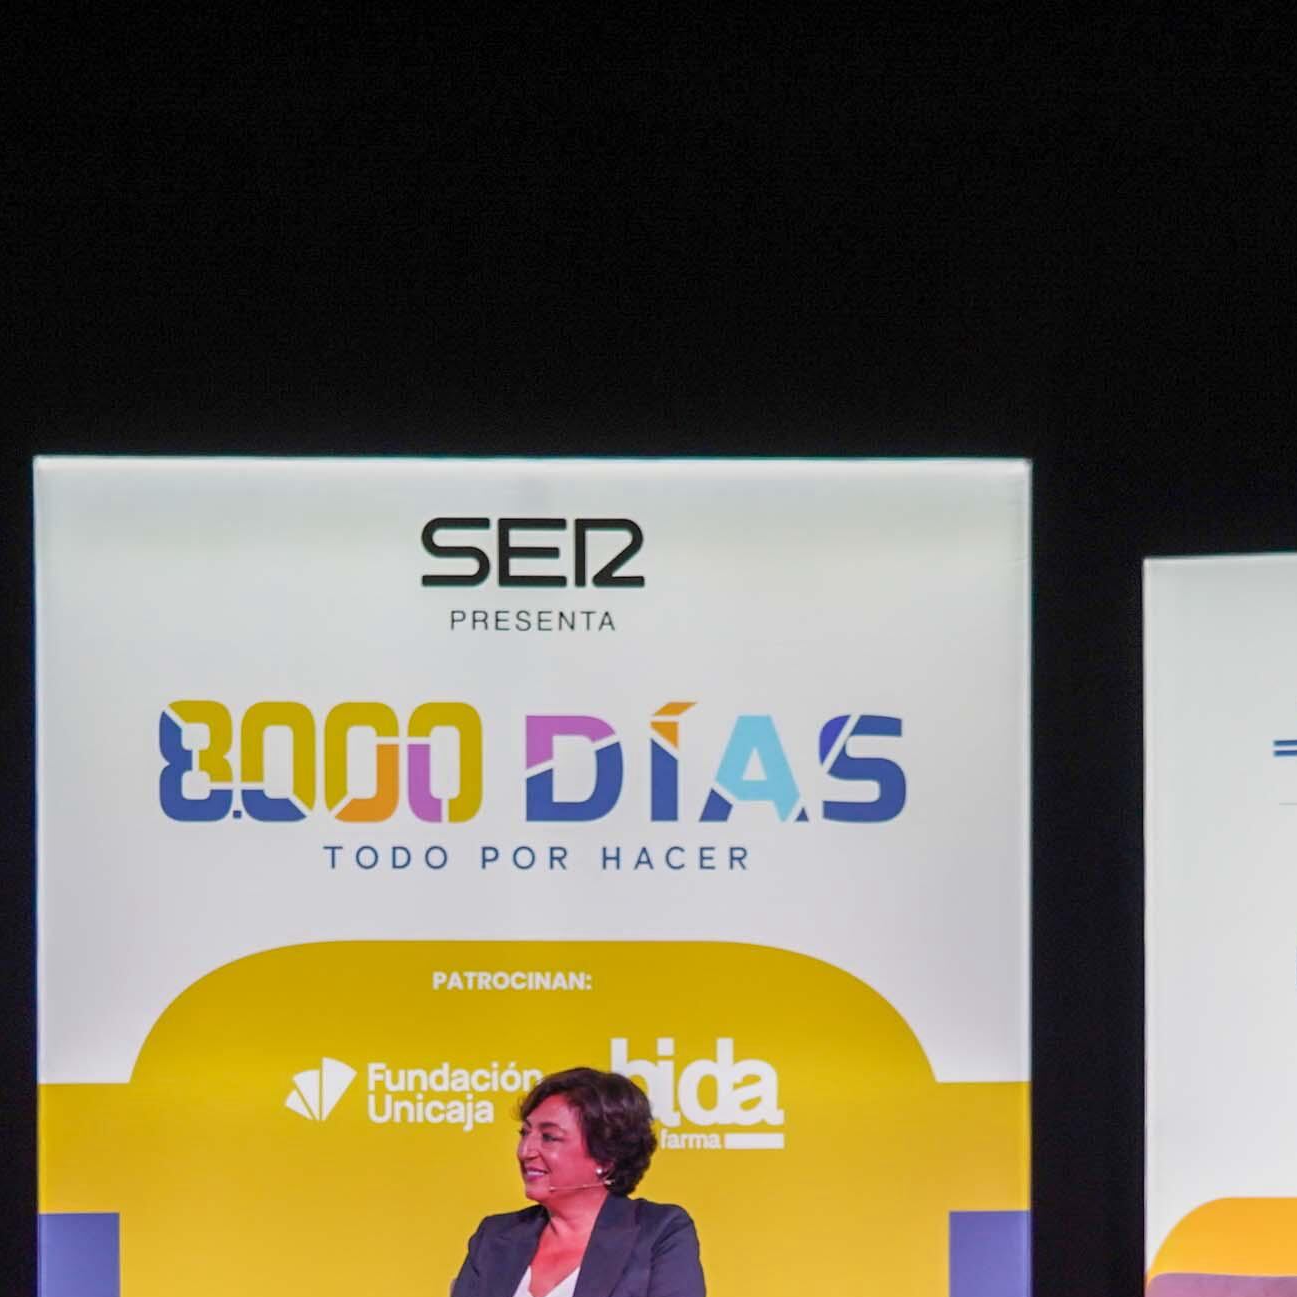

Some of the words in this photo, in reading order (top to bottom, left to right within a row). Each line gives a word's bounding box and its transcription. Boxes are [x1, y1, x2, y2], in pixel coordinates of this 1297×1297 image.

[421, 517, 645, 588] SER
[450, 610, 616, 632] PRESENTA
[159, 700, 482, 823] 8.000
[526, 702, 906, 823] DÍAS
[323, 845, 449, 870] TODO
[480, 845, 568, 870] POR
[601, 845, 748, 870] HACER
[432, 970, 593, 992] PATROCINAN:
[367, 1061, 543, 1092] Fundación
[368, 1094, 495, 1131] Unicaja
[660, 1130, 722, 1149] farma
